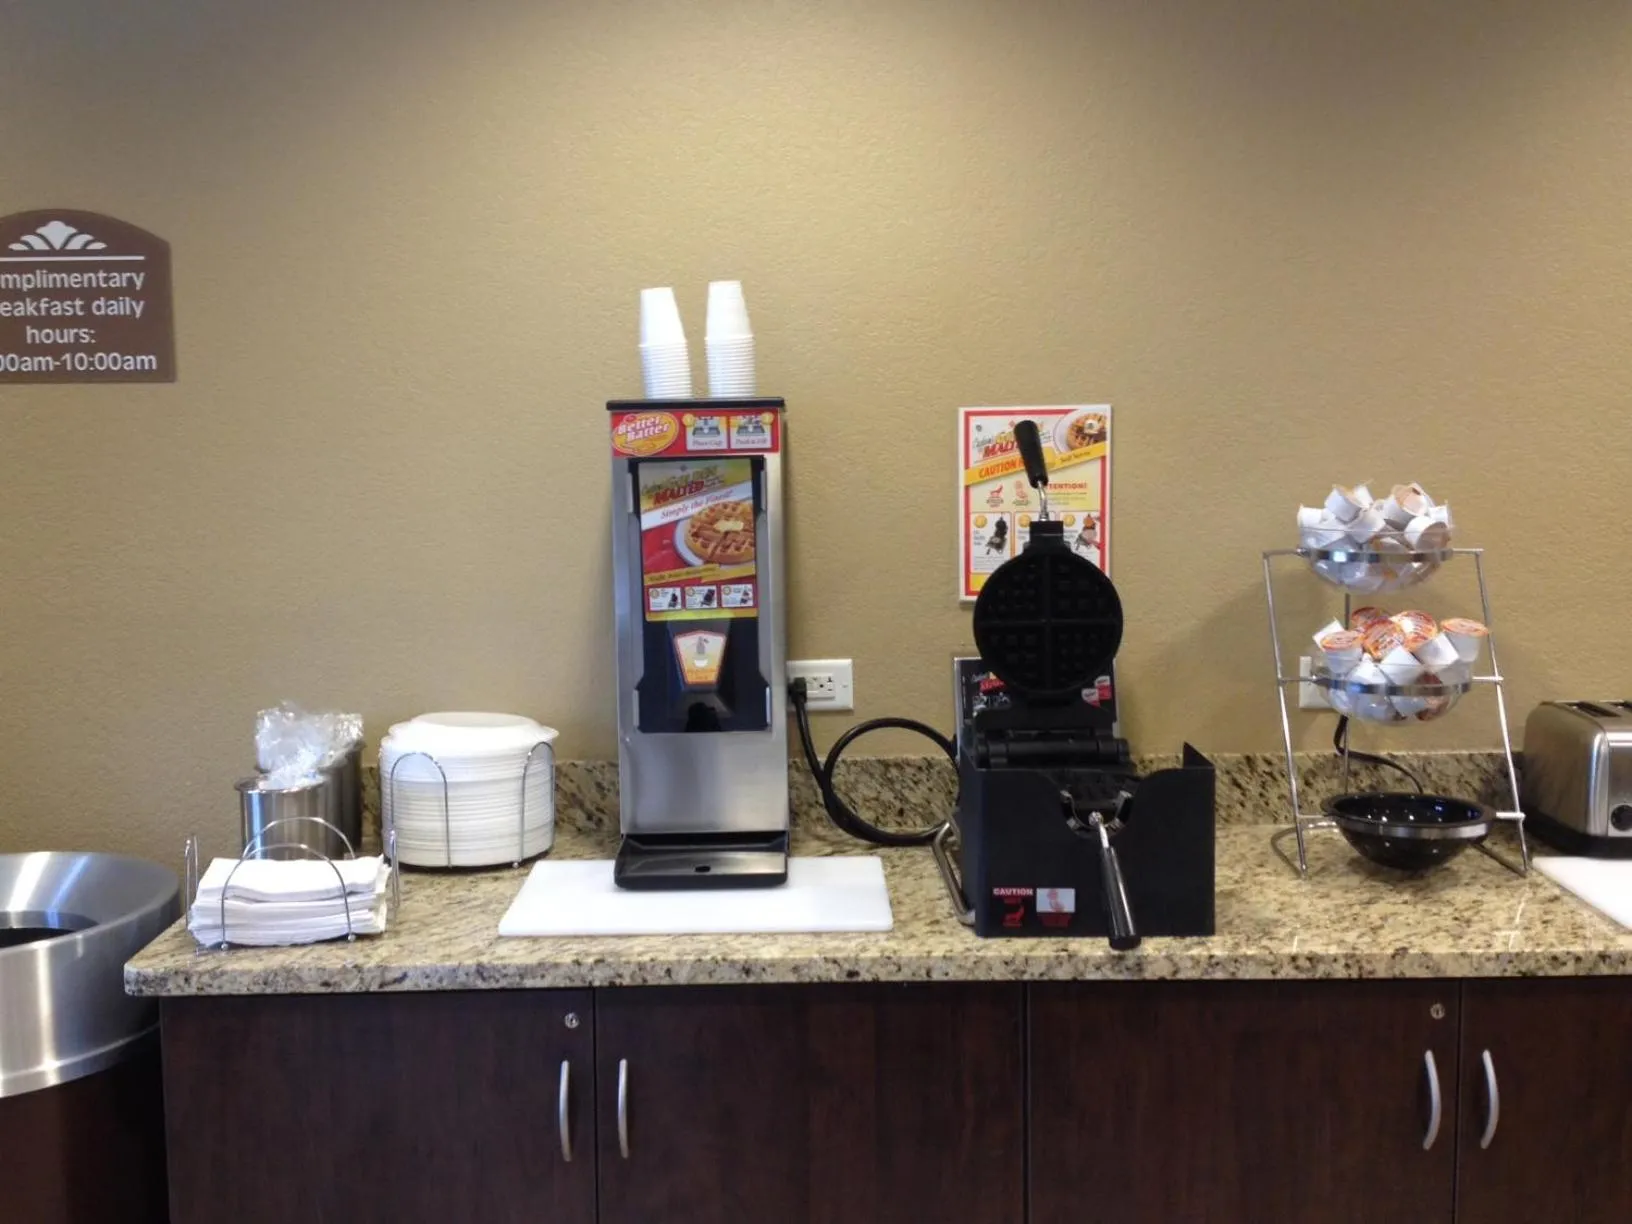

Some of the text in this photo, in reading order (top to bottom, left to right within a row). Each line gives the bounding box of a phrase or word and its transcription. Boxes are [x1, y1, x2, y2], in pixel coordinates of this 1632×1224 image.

[0, 270, 145, 291] mplimentary
[0, 297, 145, 319] eakfast daily
[26, 325, 96, 344] hours:
[978, 458, 1018, 479] CAUTION
[993, 887, 1034, 896] CAUTION
